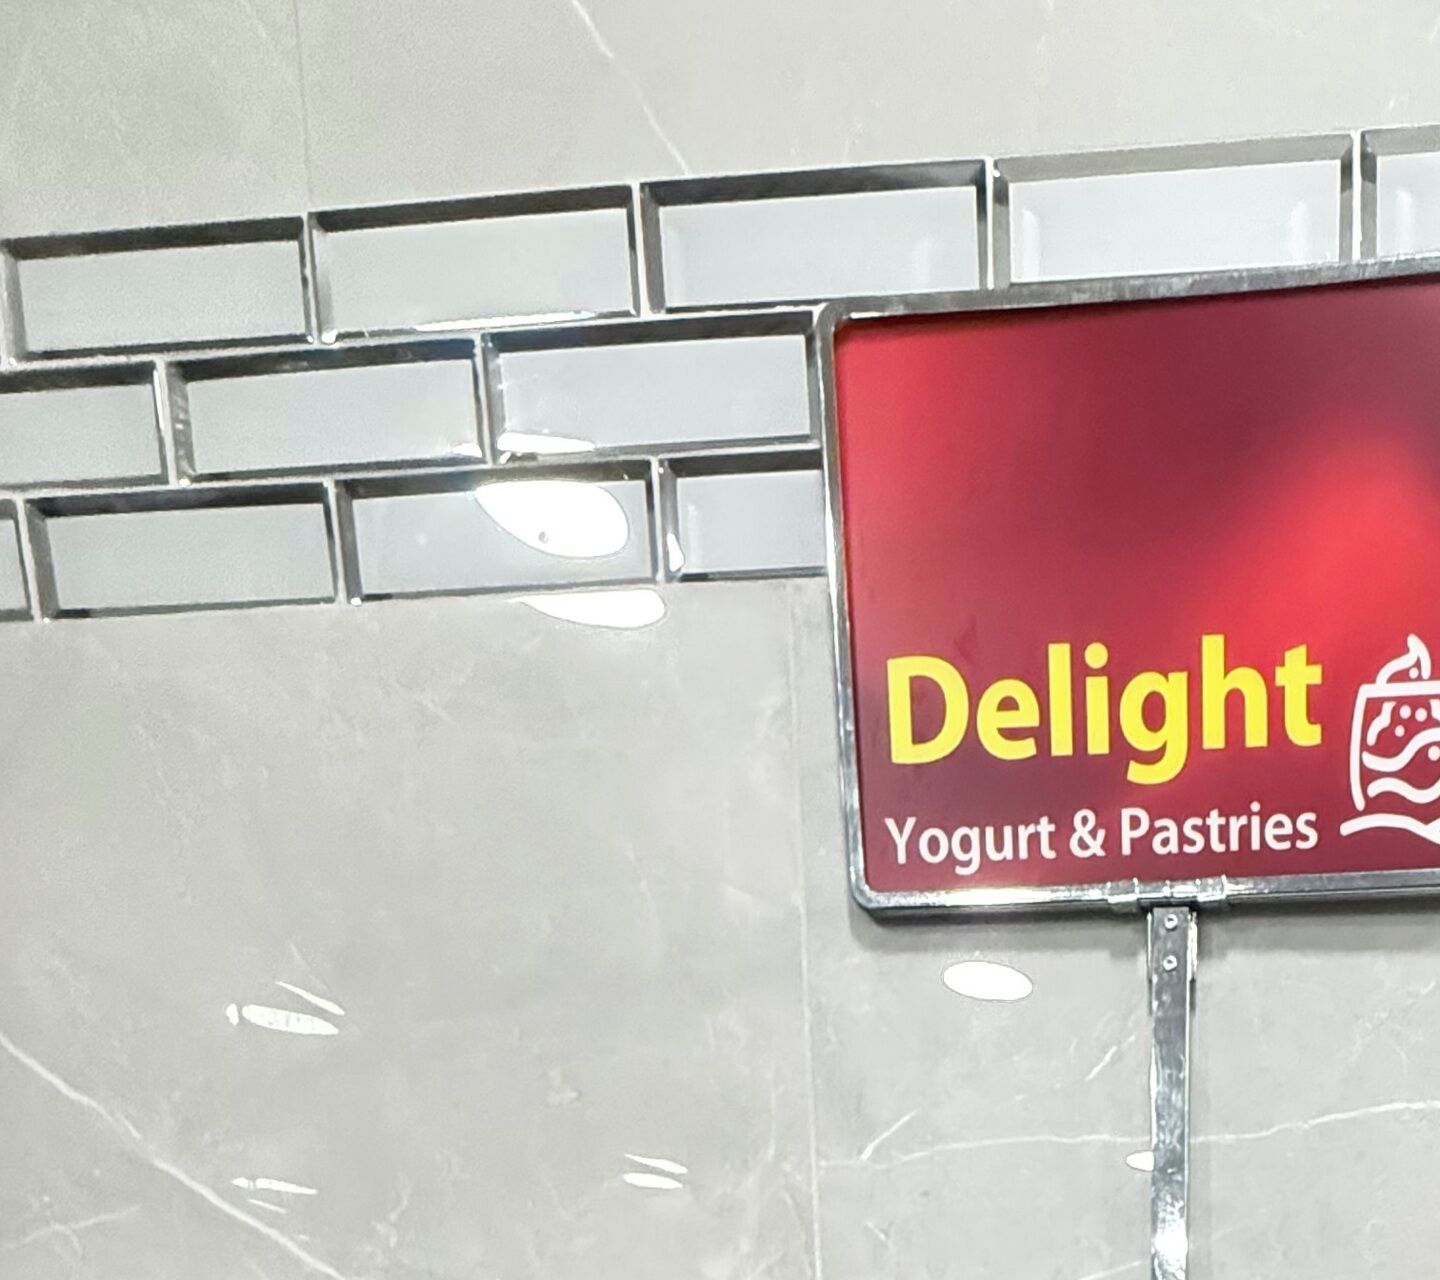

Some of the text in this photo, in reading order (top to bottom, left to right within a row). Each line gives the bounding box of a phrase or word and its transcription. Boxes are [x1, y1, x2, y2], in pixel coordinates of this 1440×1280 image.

[886, 634, 1322, 785] Delight
[885, 801, 1318, 875] Yogurt & Pastries
